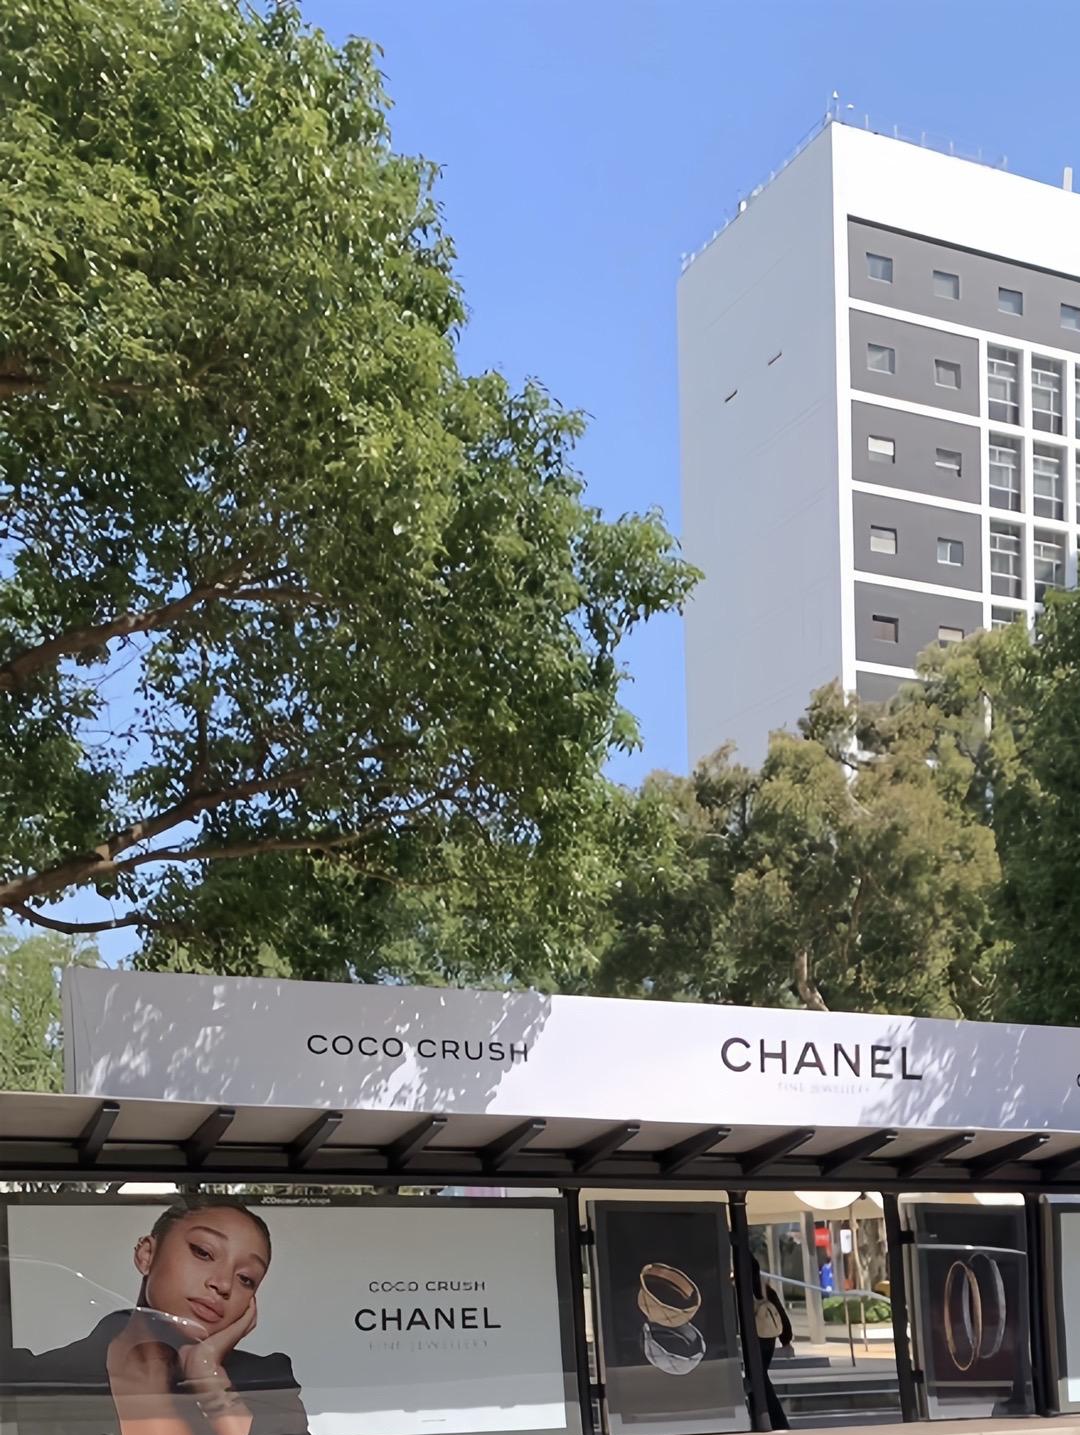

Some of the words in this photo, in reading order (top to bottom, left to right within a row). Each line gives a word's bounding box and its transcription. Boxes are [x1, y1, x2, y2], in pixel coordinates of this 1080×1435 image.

[306, 1034, 404, 1057] COCO
[417, 1038, 529, 1063] CRUSH
[720, 1037, 923, 1081] CHANEL
[368, 1281, 419, 1293] COCO
[425, 1281, 486, 1292] CRUSH
[354, 1306, 502, 1332] CHANEL
